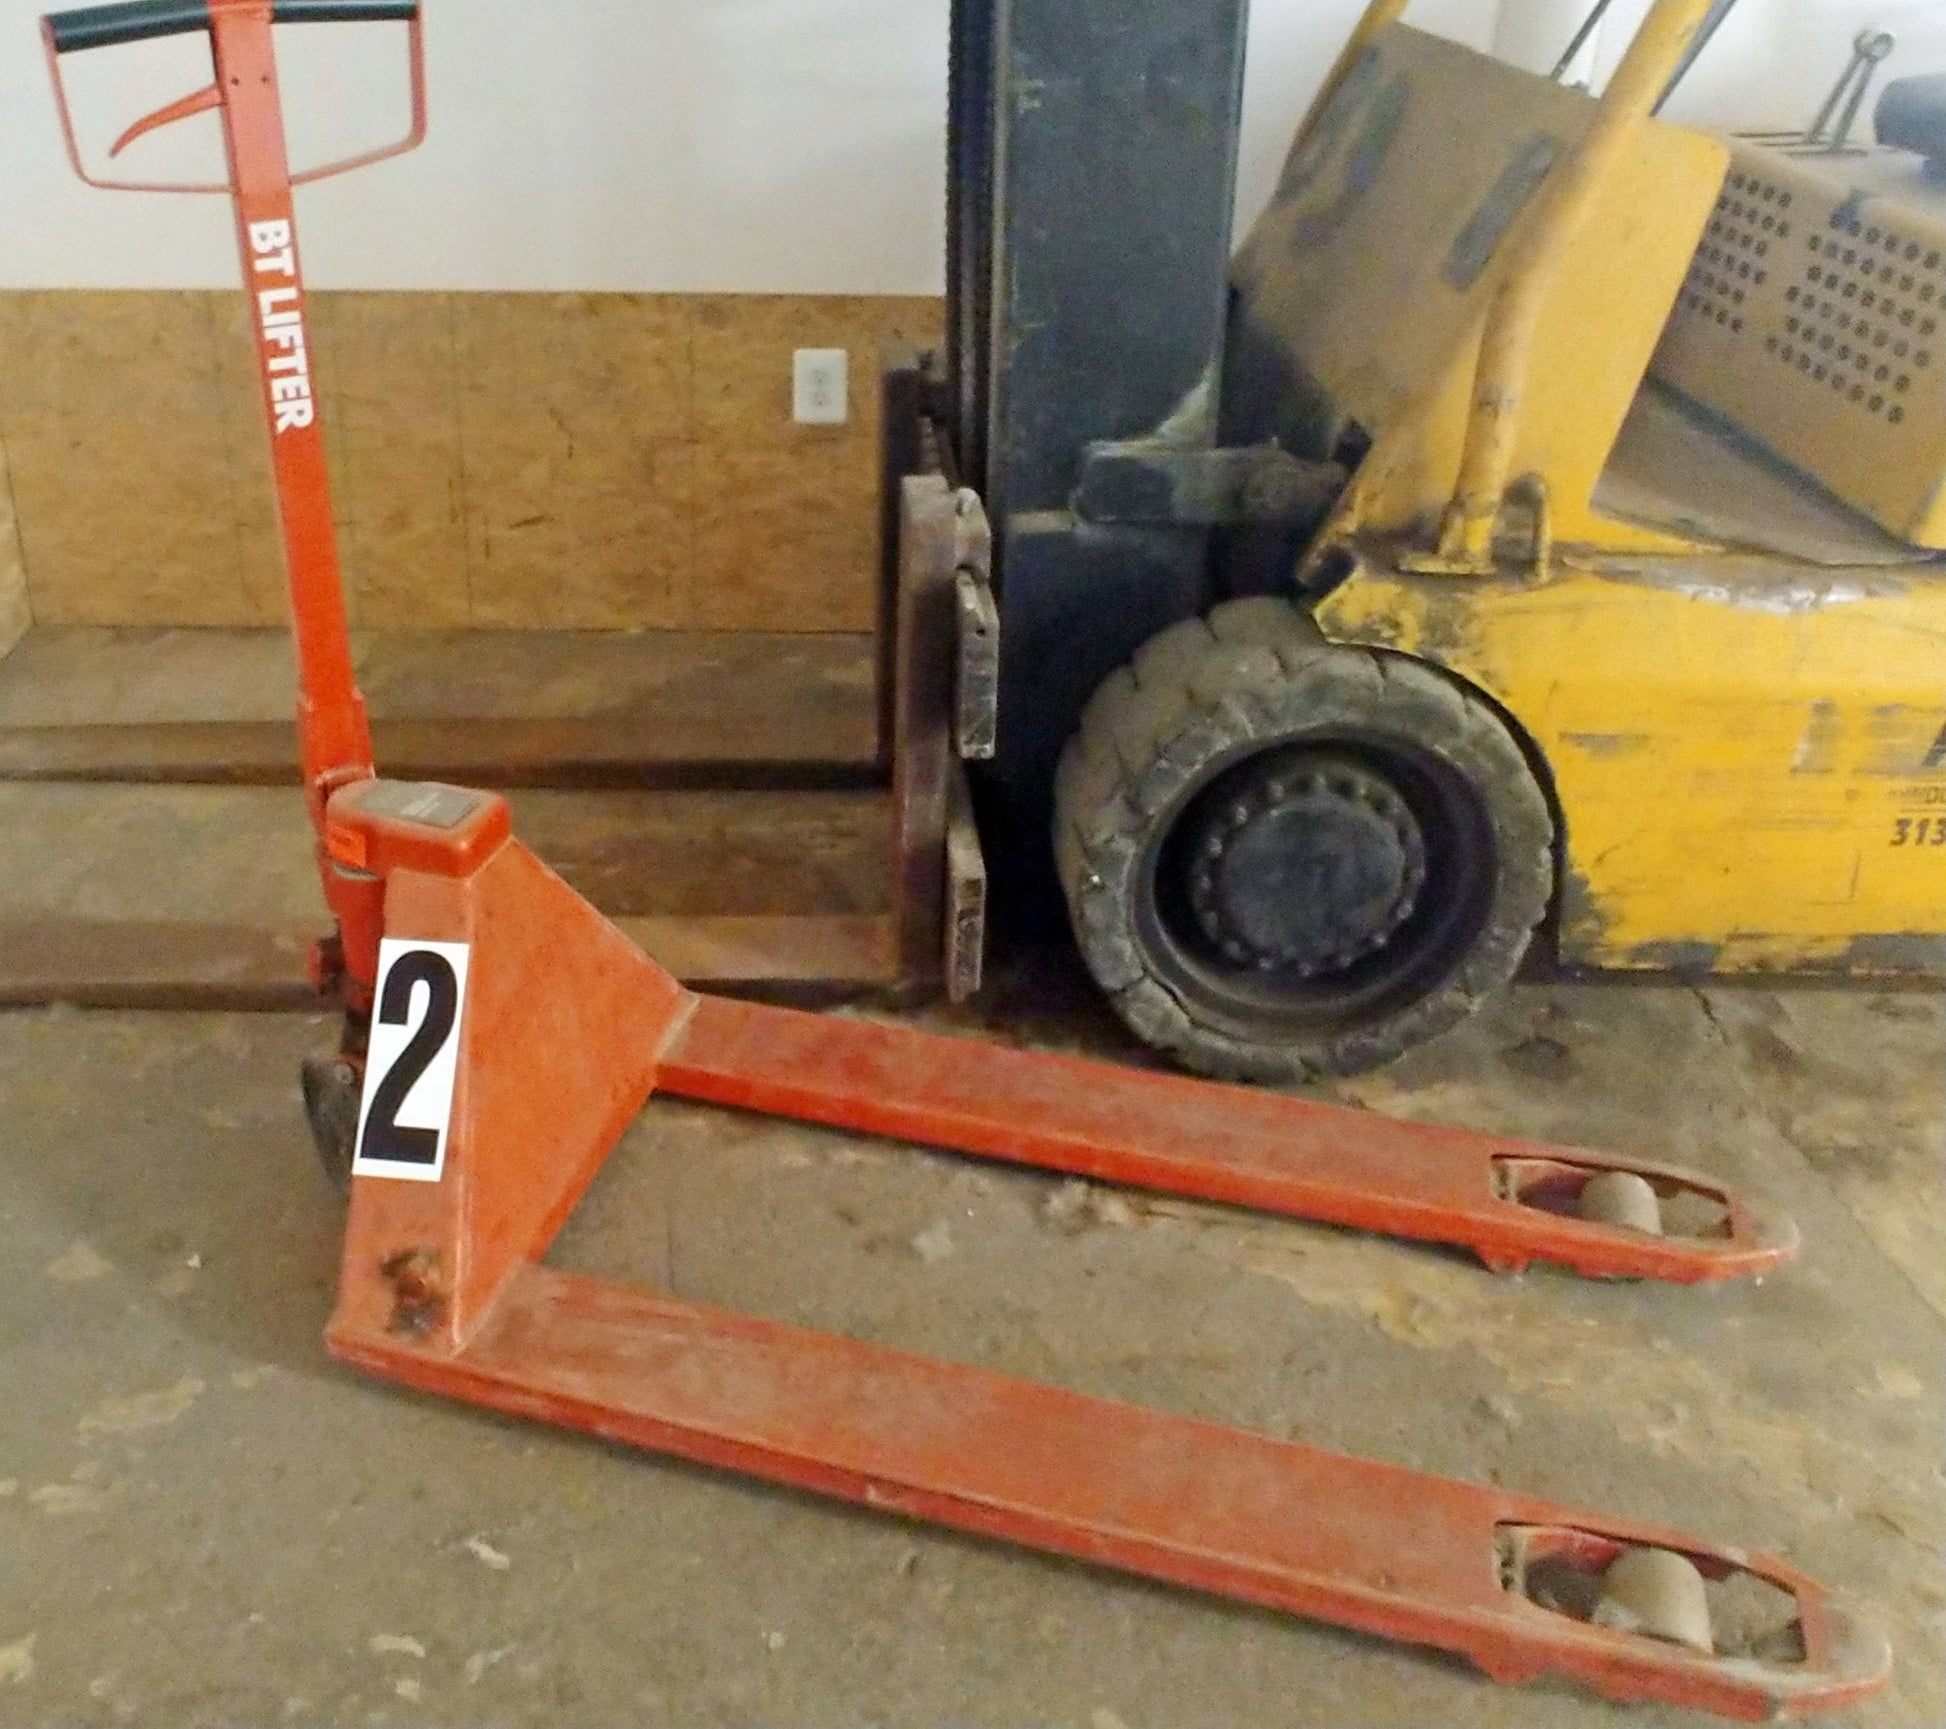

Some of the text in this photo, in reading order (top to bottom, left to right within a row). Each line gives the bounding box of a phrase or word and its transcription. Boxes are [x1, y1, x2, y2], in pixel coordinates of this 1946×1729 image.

[249, 219, 314, 435] BT LIFTER
[359, 949, 458, 1165] 2
